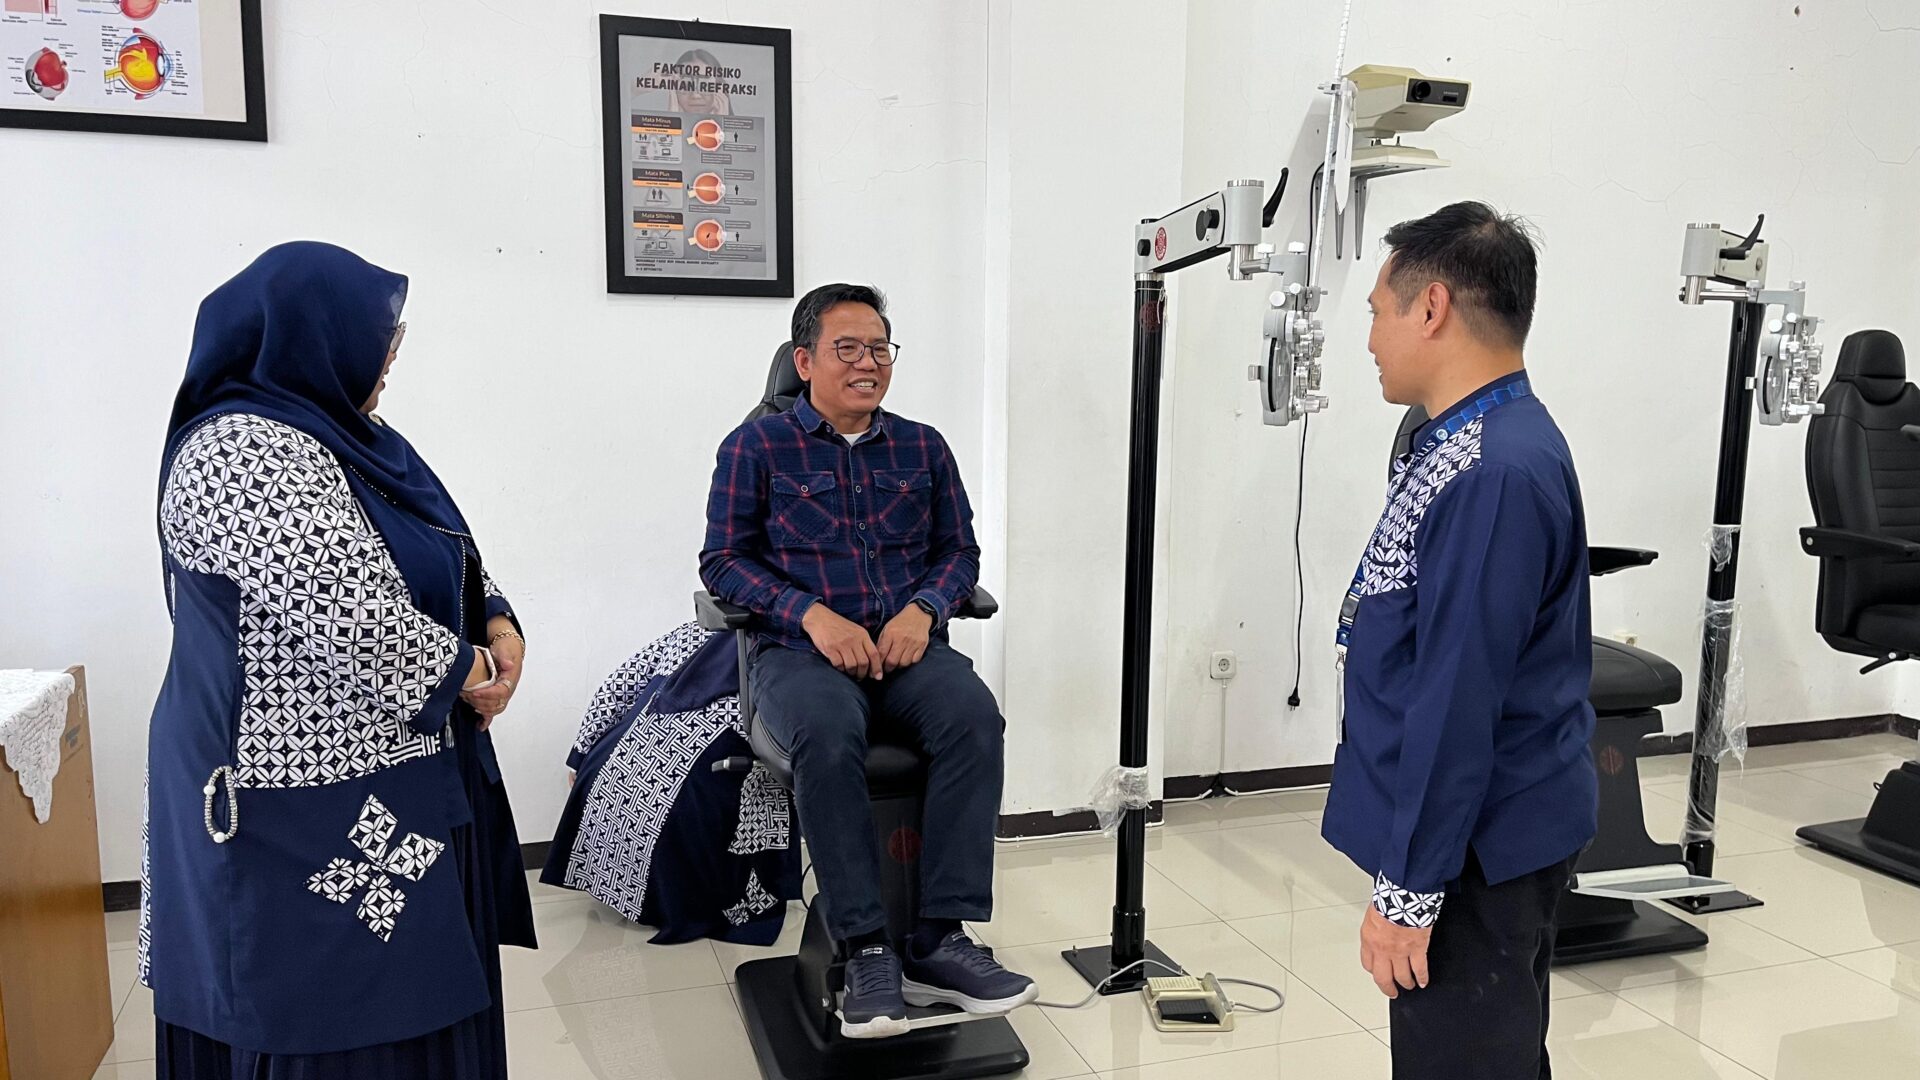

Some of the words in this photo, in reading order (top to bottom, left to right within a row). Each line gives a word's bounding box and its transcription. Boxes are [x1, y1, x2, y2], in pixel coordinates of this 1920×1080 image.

[653, 62, 700, 76] FAKTOR
[705, 66, 742, 79] RISIKO
[636, 77, 696, 92] KELAINAN
[699, 81, 757, 96] REFRAKSI
